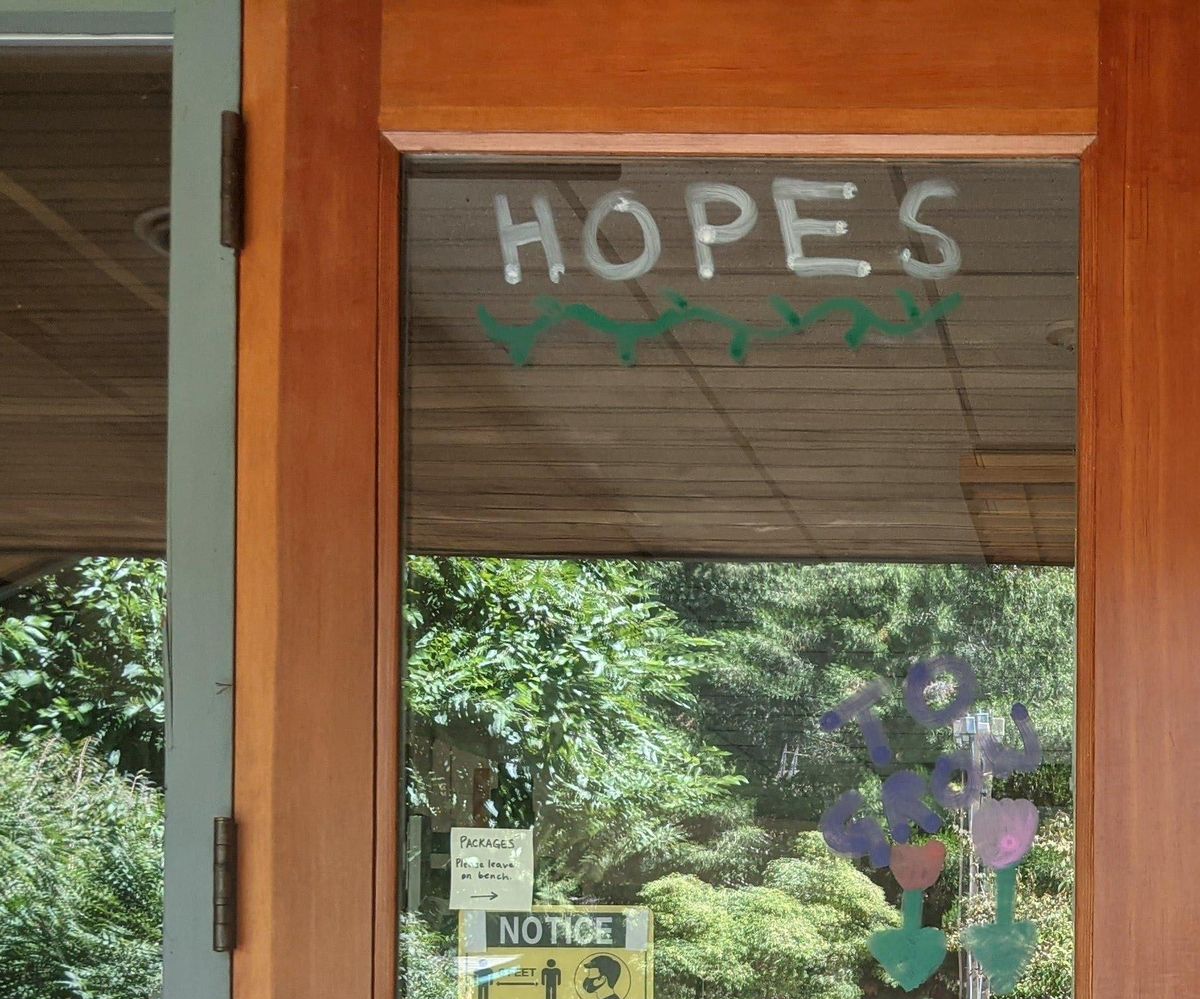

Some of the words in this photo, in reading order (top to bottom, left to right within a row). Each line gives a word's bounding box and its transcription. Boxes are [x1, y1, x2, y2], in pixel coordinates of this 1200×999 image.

[494, 176, 962, 284] HOPES
[819, 654, 978, 768] TO
[459, 835, 516, 849] PACKAGES
[455, 857, 485, 869] Plese
[487, 860, 516, 869] leave
[500, 915, 614, 945] NOTICE
